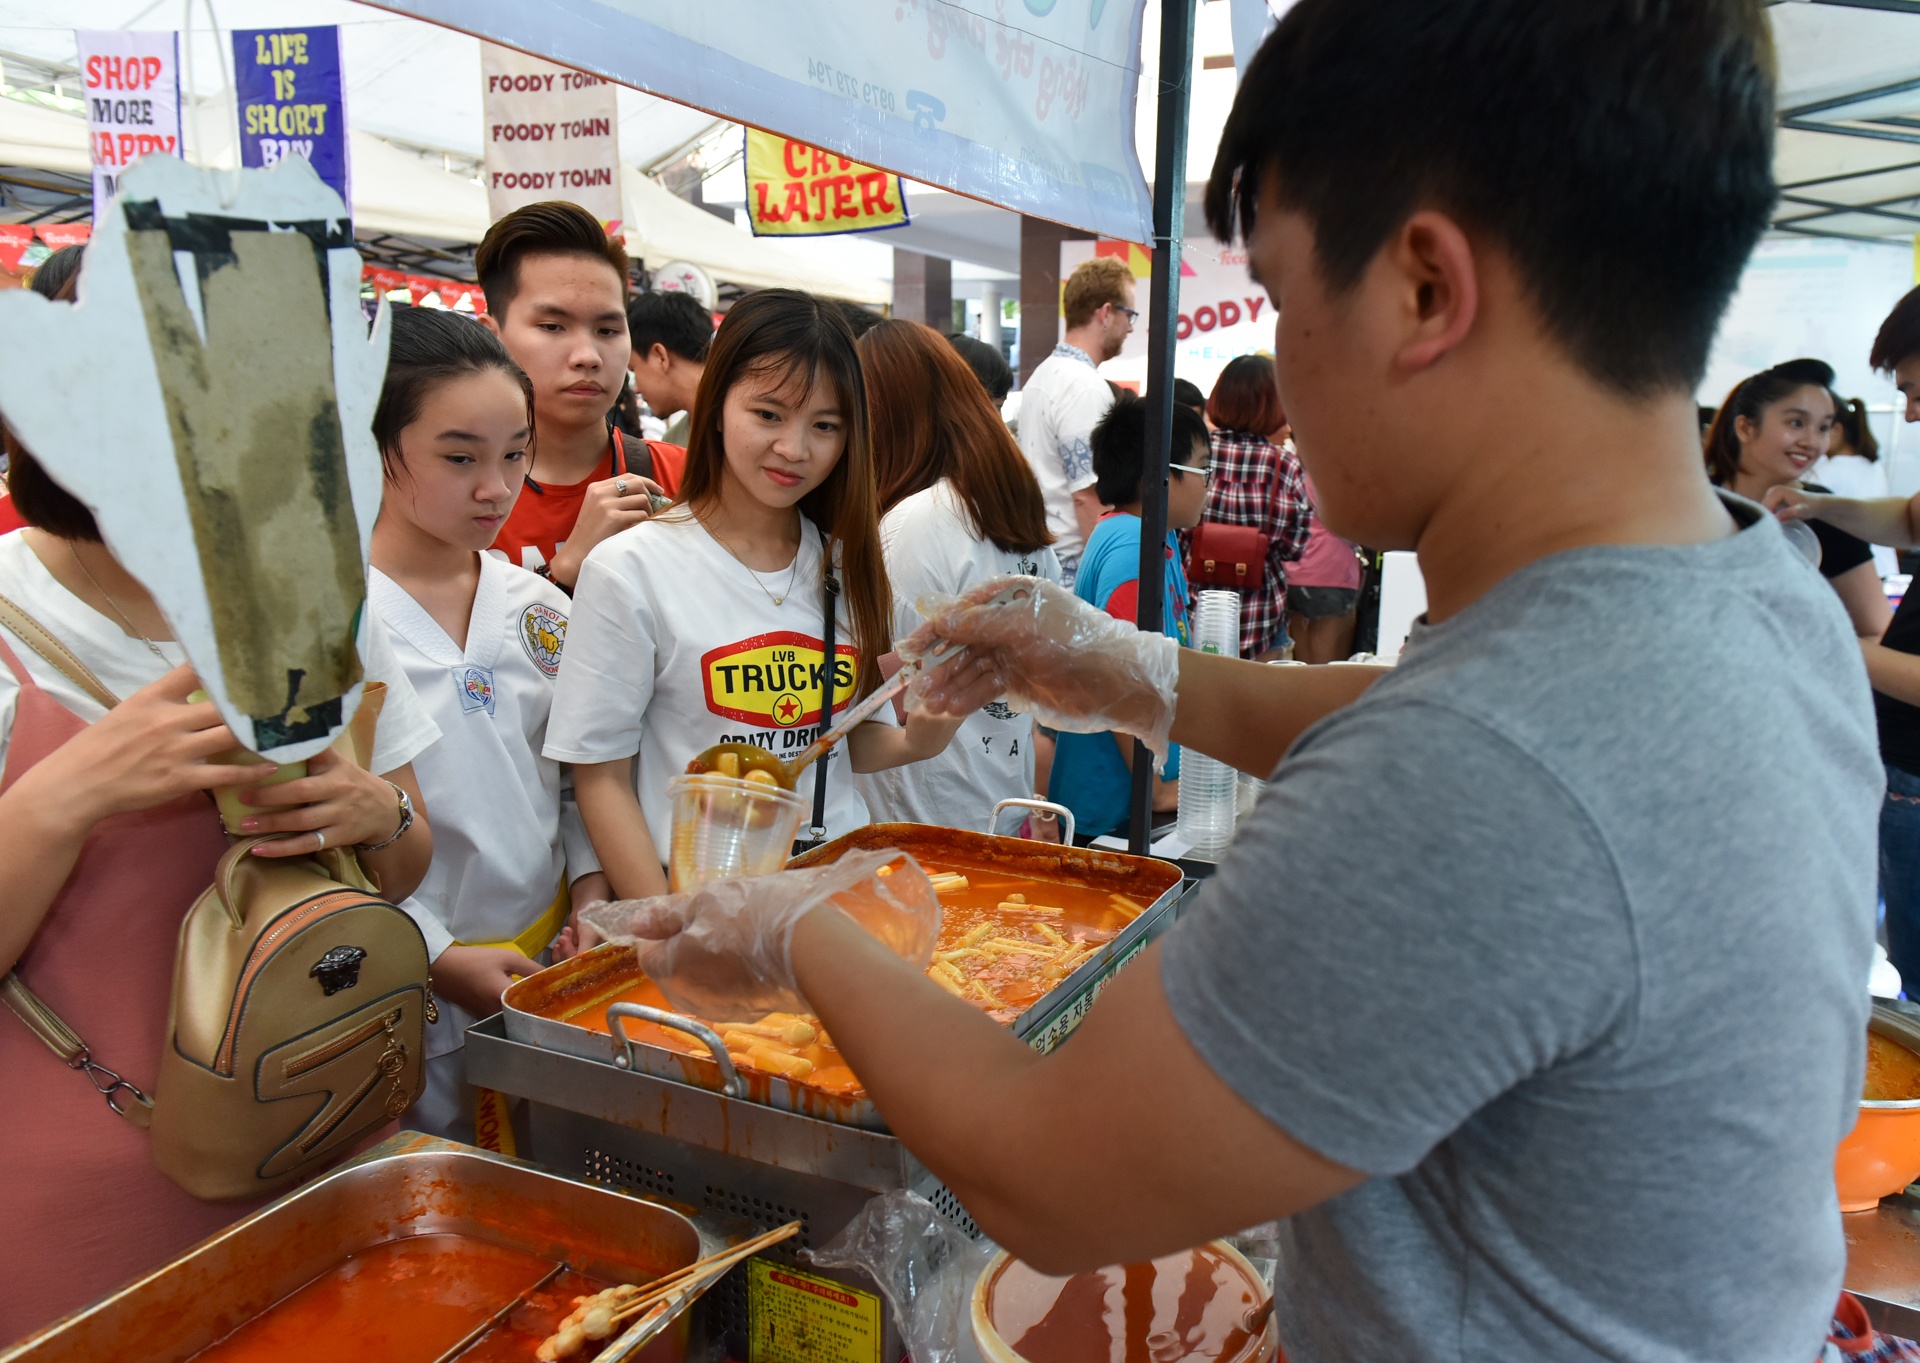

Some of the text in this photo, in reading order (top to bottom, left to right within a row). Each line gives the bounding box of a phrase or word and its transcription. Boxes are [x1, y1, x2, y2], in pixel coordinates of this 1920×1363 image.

[255, 33, 309, 65] LIFE
[86, 54, 162, 90] SHOP
[271, 69, 296, 101] IS
[489, 74, 555, 93] FOODY
[92, 98, 154, 125] MORE
[245, 103, 328, 137] SHORT
[492, 118, 610, 142] FOODY TOWN
[492, 168, 611, 189] FOODY TOWN
[754, 172, 896, 223] LATER
[1176, 297, 1266, 340] OODY
[534, 606, 560, 621] HANOI
[772, 651, 796, 663] LVB
[716, 660, 854, 694] TRUCKS
